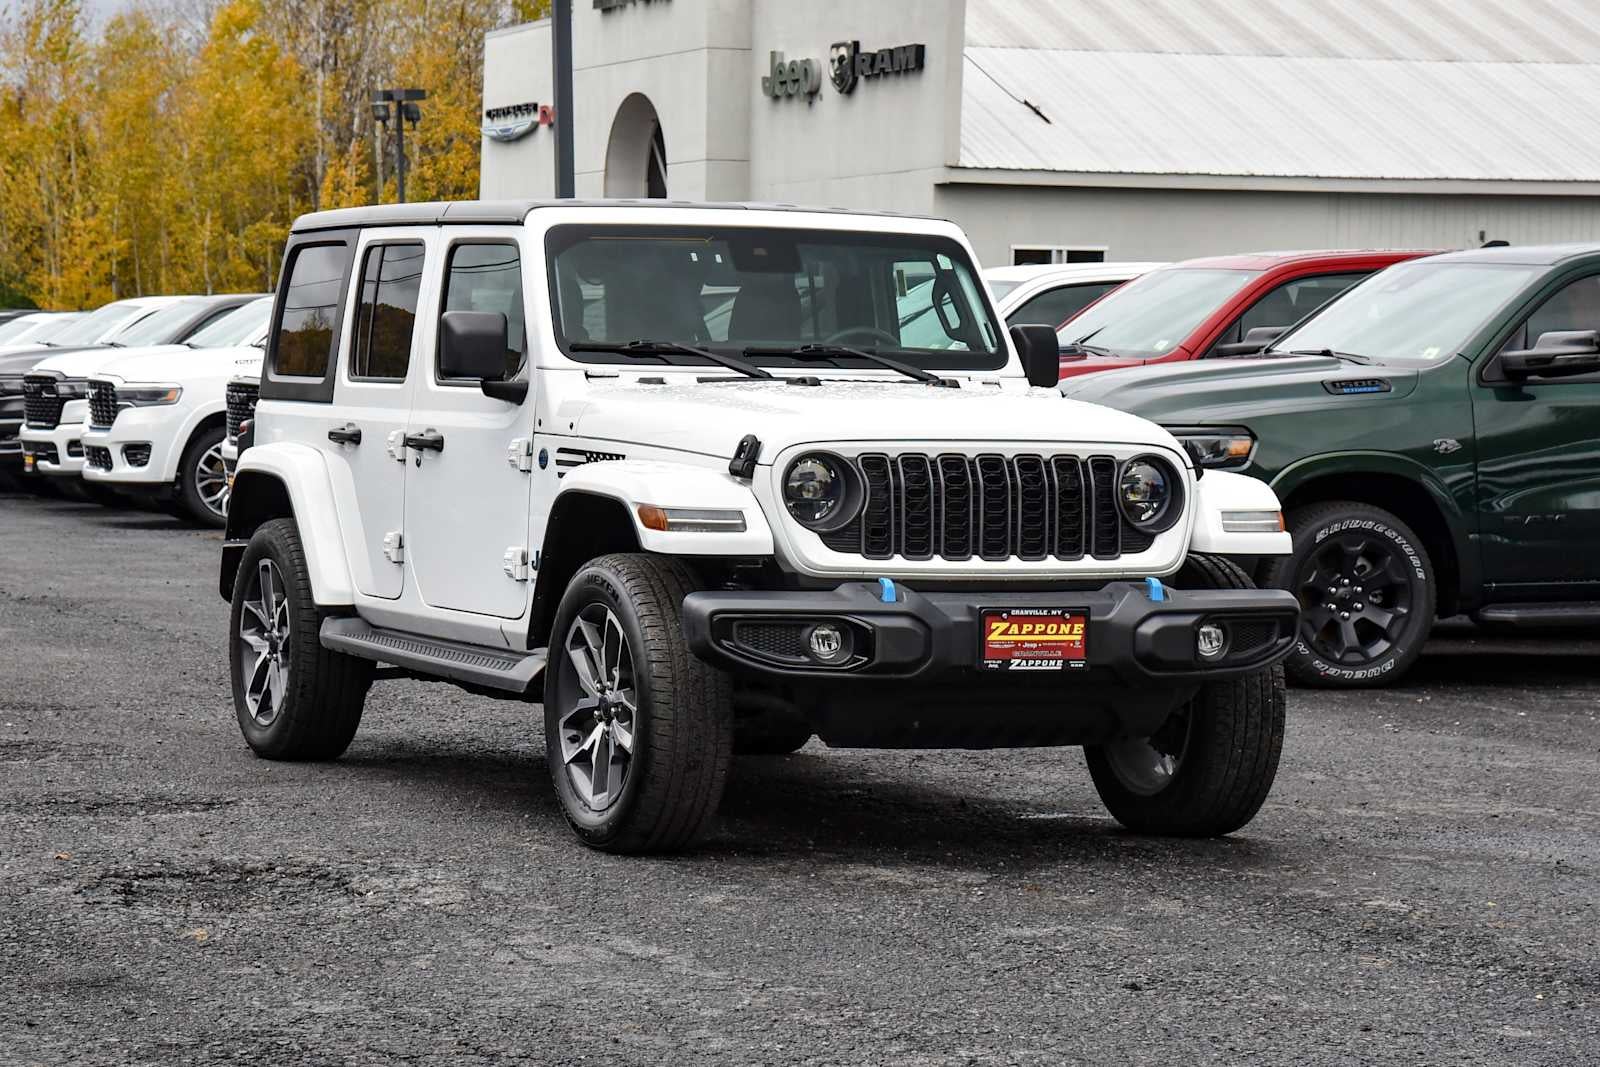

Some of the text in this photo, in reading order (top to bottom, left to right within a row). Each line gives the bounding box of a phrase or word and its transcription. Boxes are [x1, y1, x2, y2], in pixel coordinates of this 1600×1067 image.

[855, 44, 925, 76] RAM
[761, 51, 821, 102] Jeep
[1315, 519, 1426, 580] BRIDGESTONE
[987, 622, 1084, 640] ZAPPONE
[1008, 659, 1064, 670] ZAPPONE
